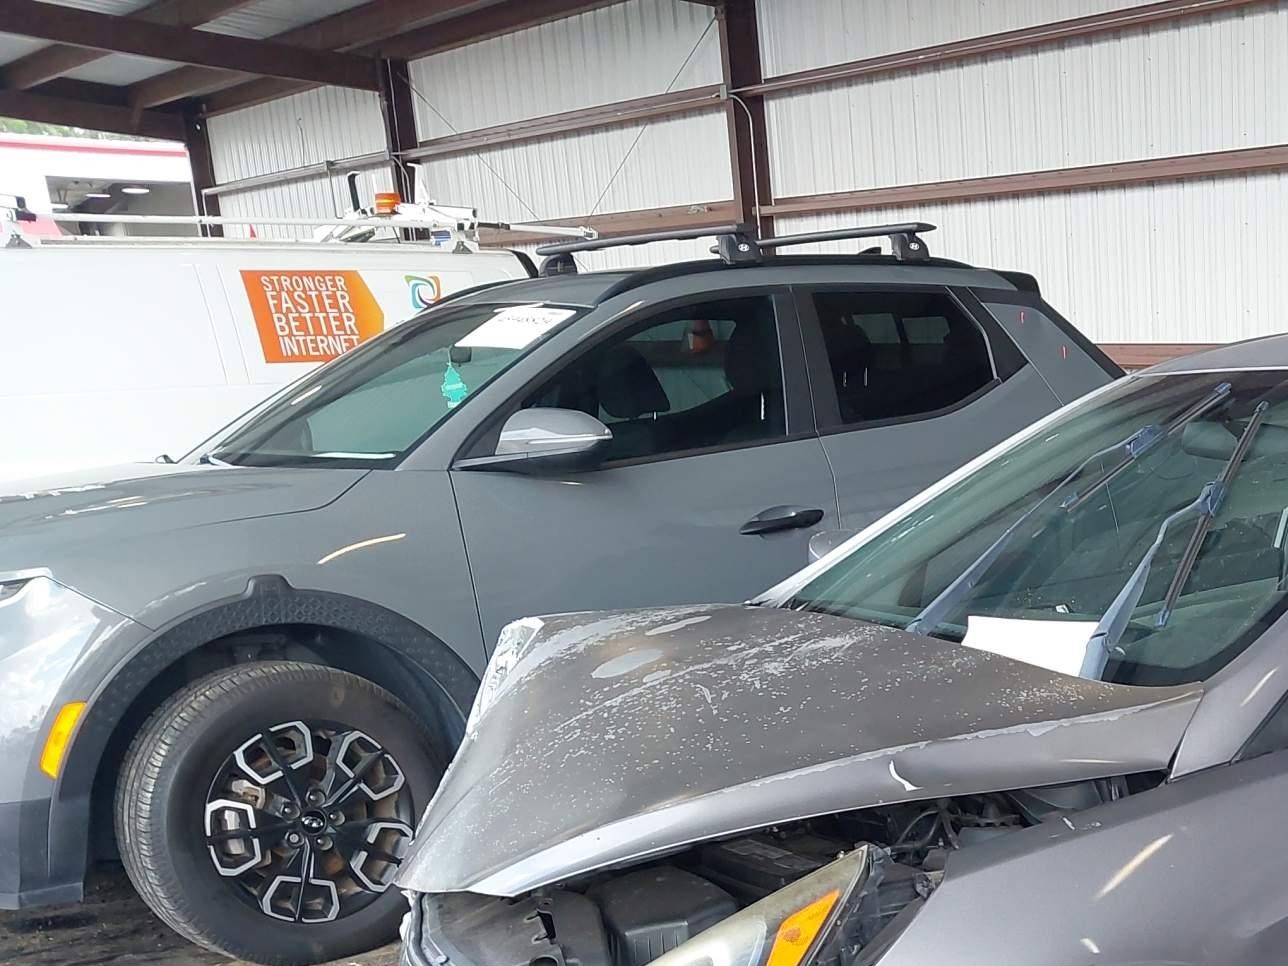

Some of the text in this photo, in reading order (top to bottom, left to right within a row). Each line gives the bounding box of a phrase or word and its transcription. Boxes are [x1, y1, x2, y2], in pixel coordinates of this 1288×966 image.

[261, 276, 348, 292] STRONGER
[266, 291, 353, 313] FASTER
[273, 312, 360, 335] BETTER
